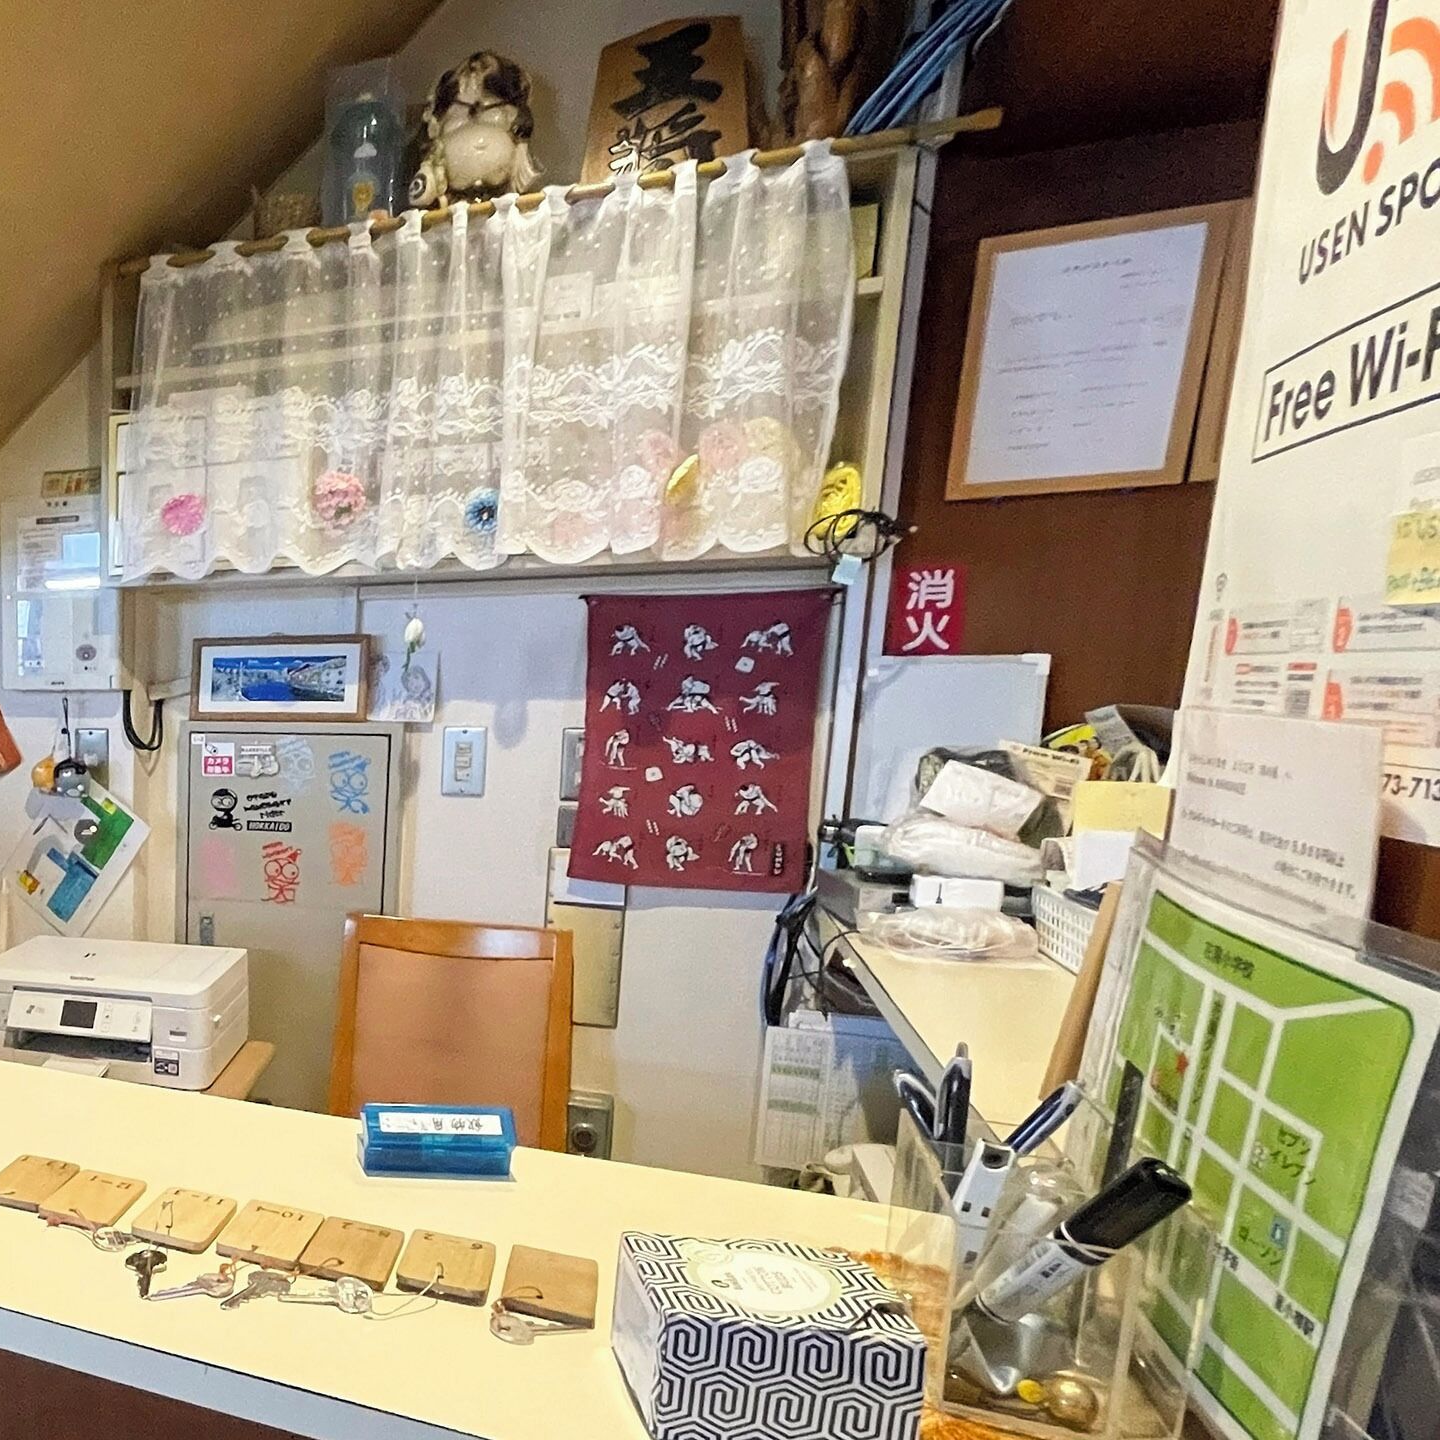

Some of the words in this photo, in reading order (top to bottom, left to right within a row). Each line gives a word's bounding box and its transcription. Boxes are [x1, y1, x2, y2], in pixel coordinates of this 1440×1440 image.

[1298, 200, 1371, 285] USEN
[1263, 369, 1336, 443] Free
[902, 568, 955, 652] 消火
[248, 821, 291, 832] HOKKAIDO
